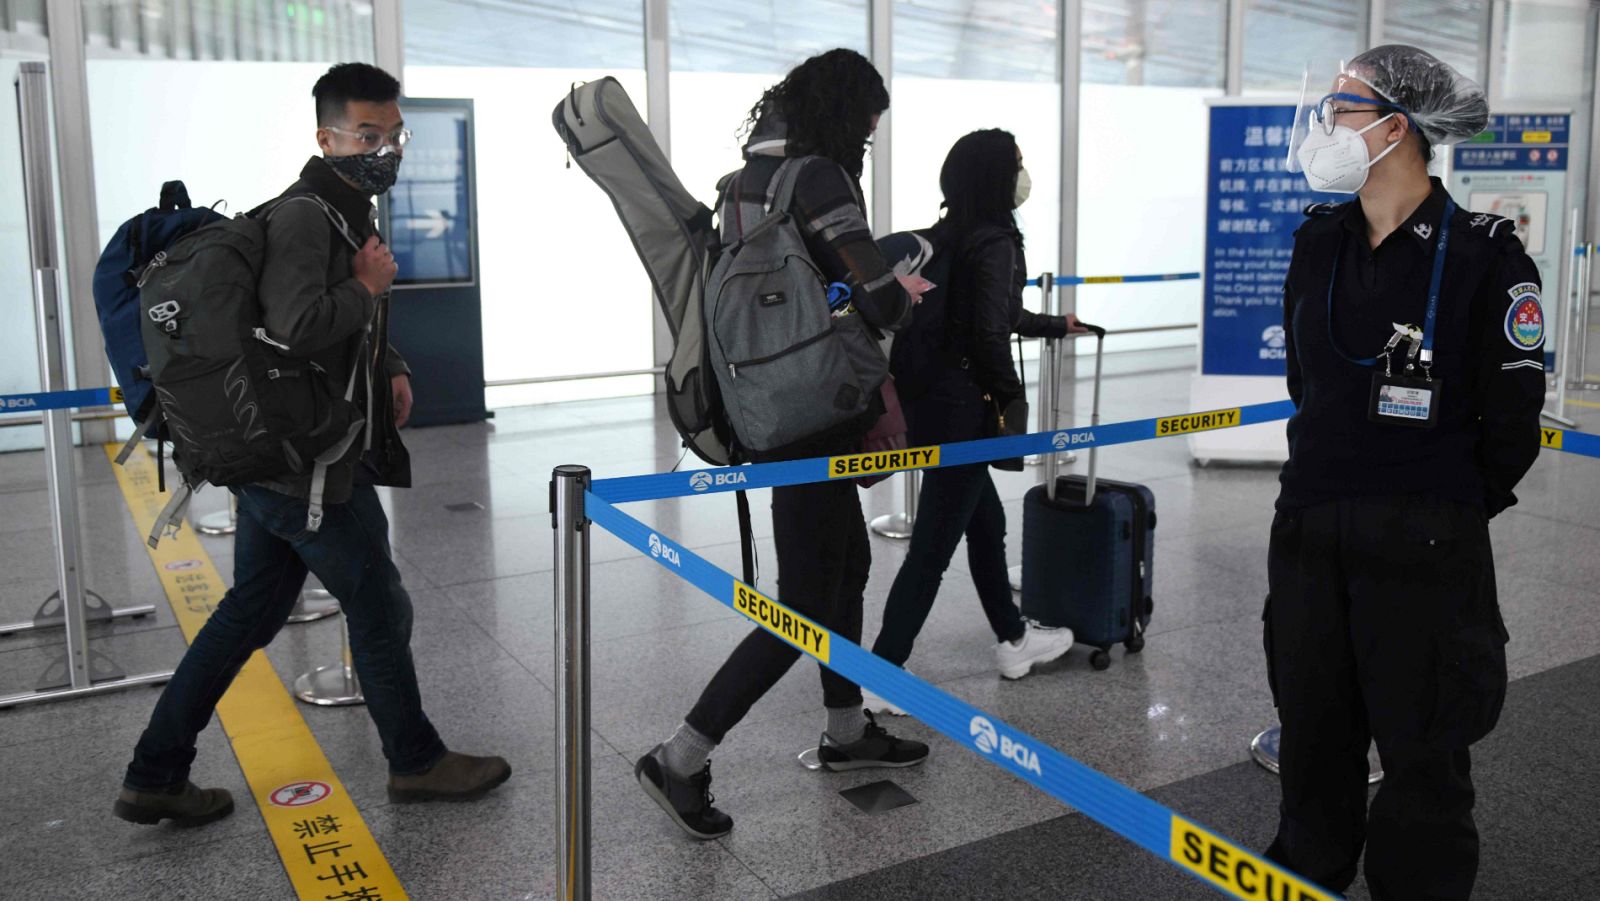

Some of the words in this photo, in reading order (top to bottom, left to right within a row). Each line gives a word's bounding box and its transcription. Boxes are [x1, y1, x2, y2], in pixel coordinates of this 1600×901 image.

[1228, 248, 1245, 257] the
[1248, 248, 1274, 257] front
[1276, 249, 1293, 257] are
[1215, 261, 1241, 269] show
[1244, 261, 1266, 271] your
[1215, 273, 1233, 281] and
[1235, 273, 1255, 281] wait
[1214, 295, 1242, 304] Thank
[1245, 297, 1262, 306] you
[1264, 296, 1278, 305] for
[1071, 431, 1096, 445] BCIA
[1160, 410, 1236, 434] SECURITY
[715, 472, 748, 487] BCIA
[834, 449, 935, 475] SECURITY
[662, 544, 681, 568] BCIA
[737, 587, 825, 654] SECURITY
[1000, 735, 1042, 777] BCIA
